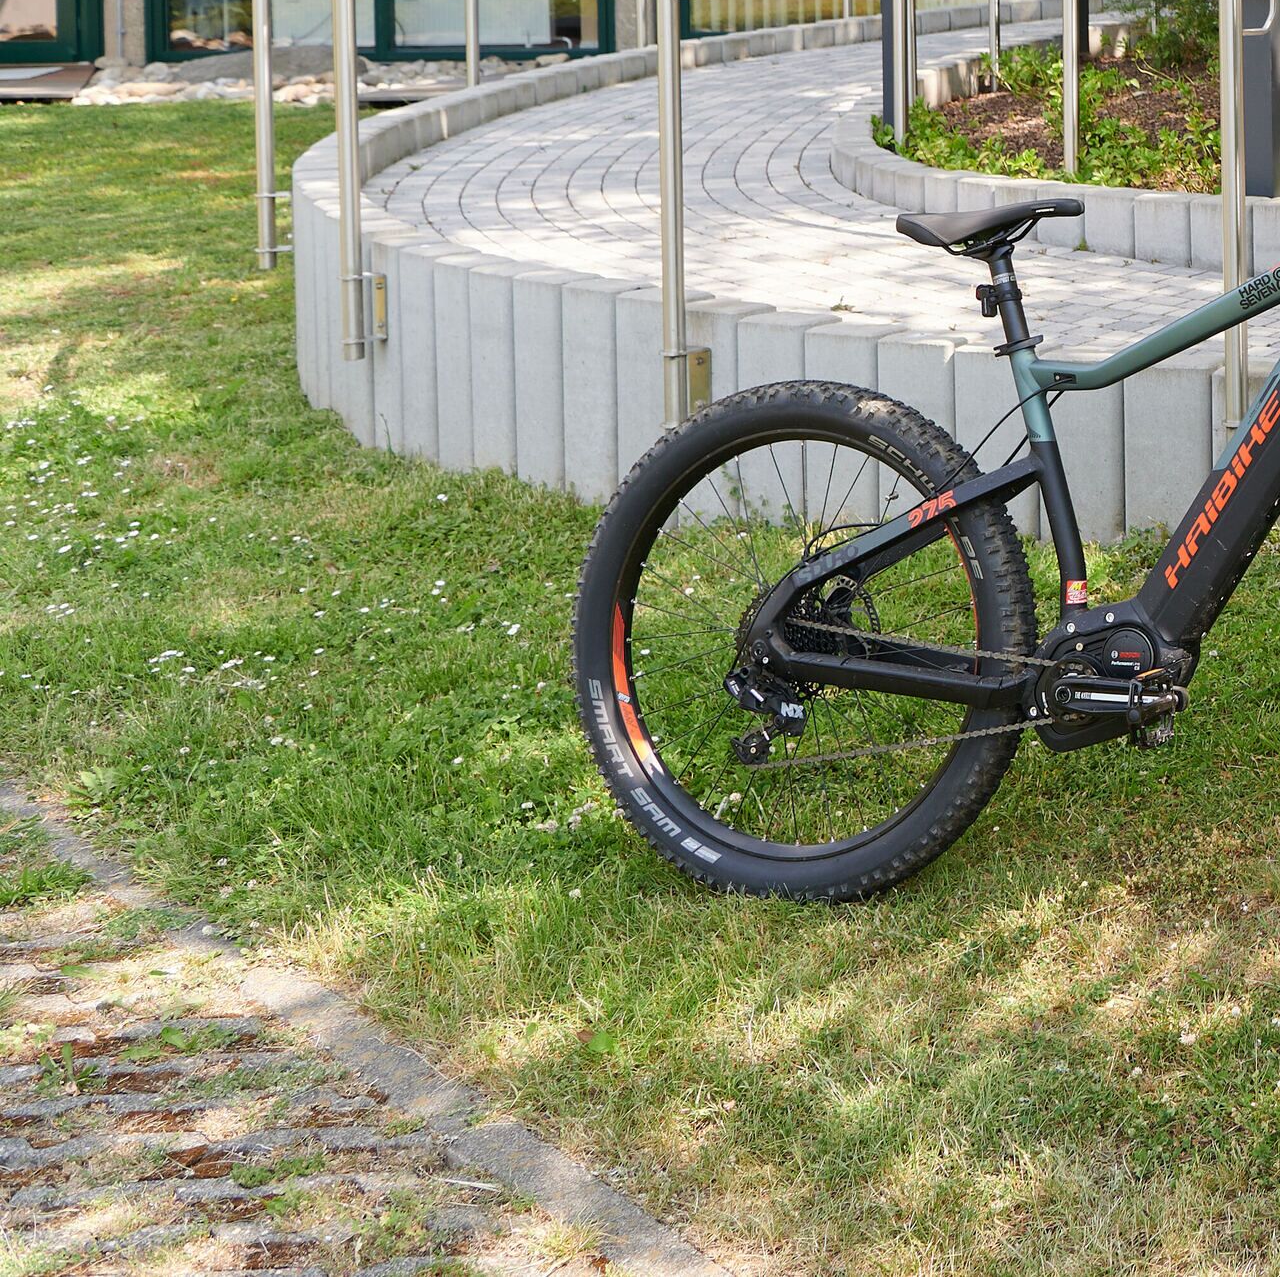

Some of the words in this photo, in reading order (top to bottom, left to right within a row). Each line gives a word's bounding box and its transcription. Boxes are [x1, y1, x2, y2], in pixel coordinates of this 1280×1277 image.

[1238, 274, 1271, 299] HARD
[1239, 282, 1278, 310] SEVEN
[780, 701, 805, 719] NX
[588, 678, 635, 779] SMART
[630, 787, 682, 838] SAM
